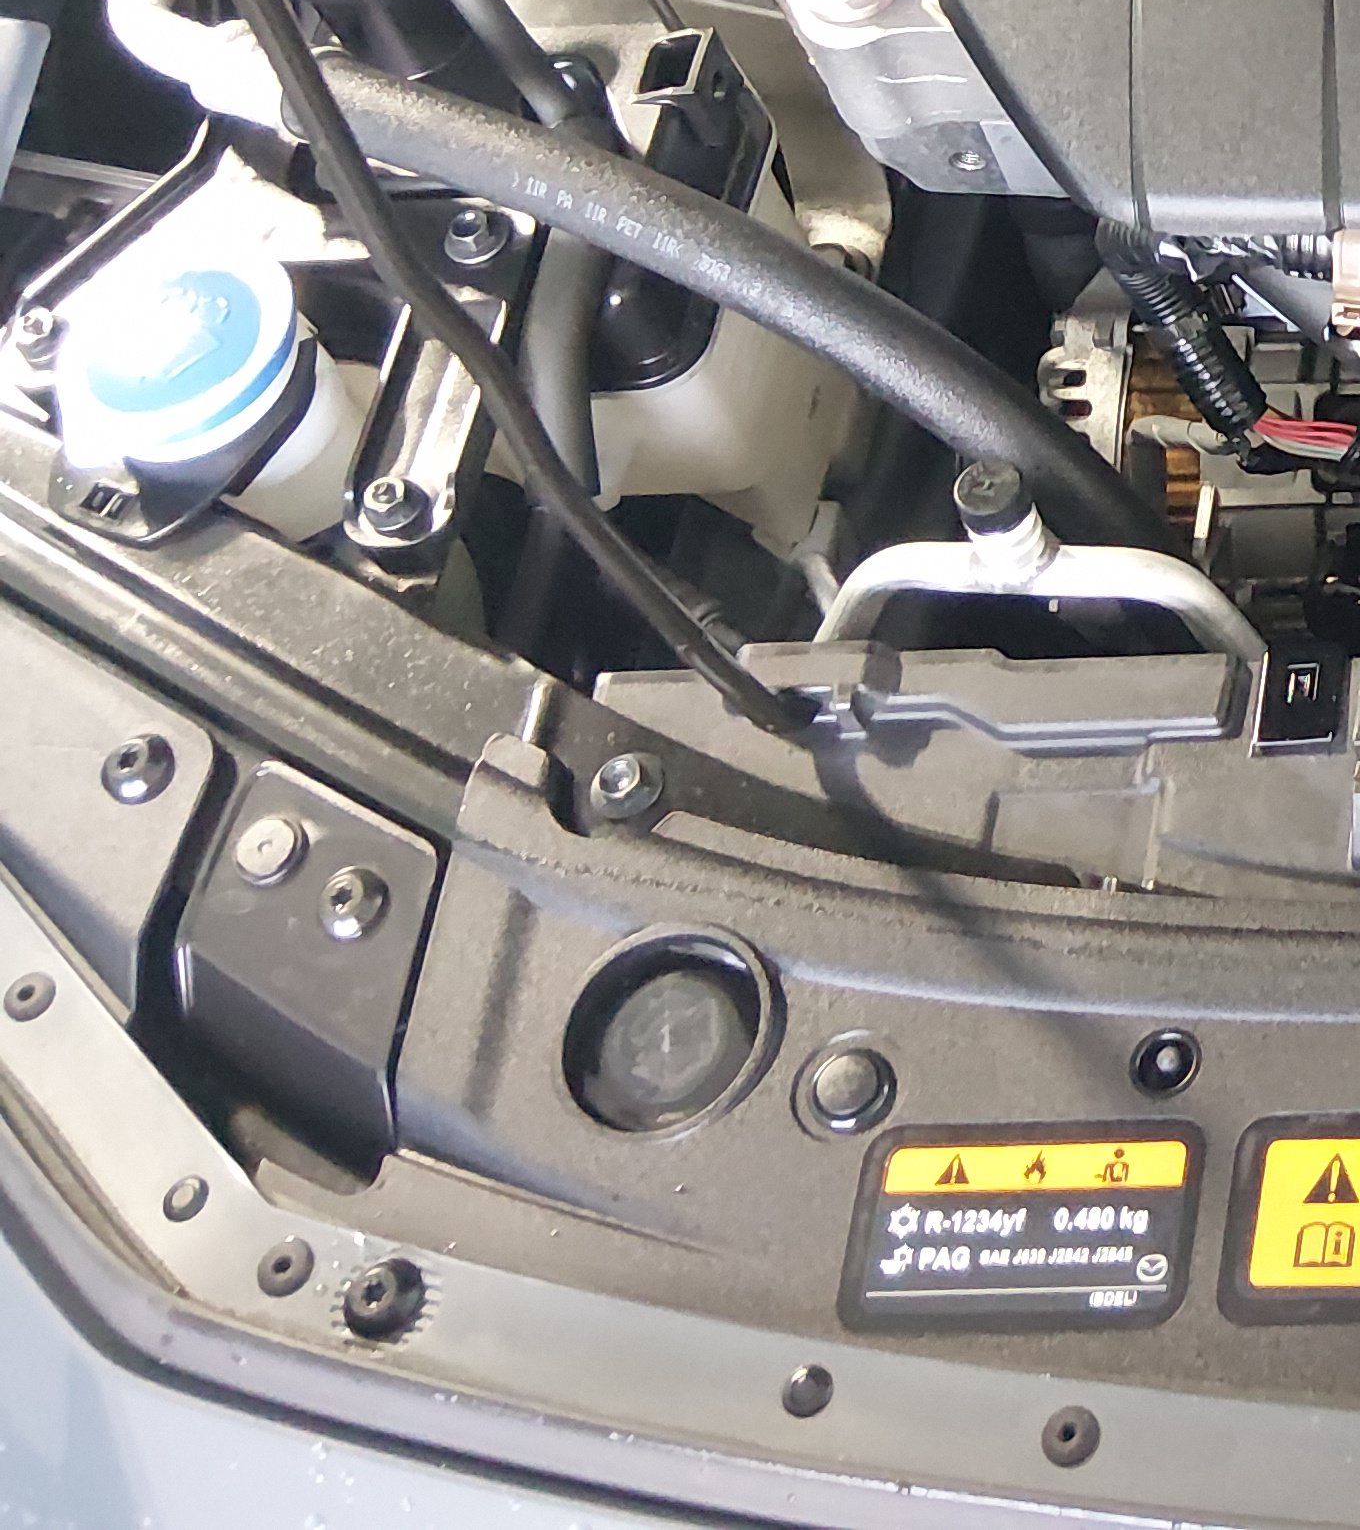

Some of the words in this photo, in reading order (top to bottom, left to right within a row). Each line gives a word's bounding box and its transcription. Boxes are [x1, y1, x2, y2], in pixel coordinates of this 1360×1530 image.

[615, 215, 643, 239] PET
[924, 1207, 1027, 1238] R-1234yf
[1119, 1206, 1149, 1235] kg
[918, 1245, 971, 1271] PAG
